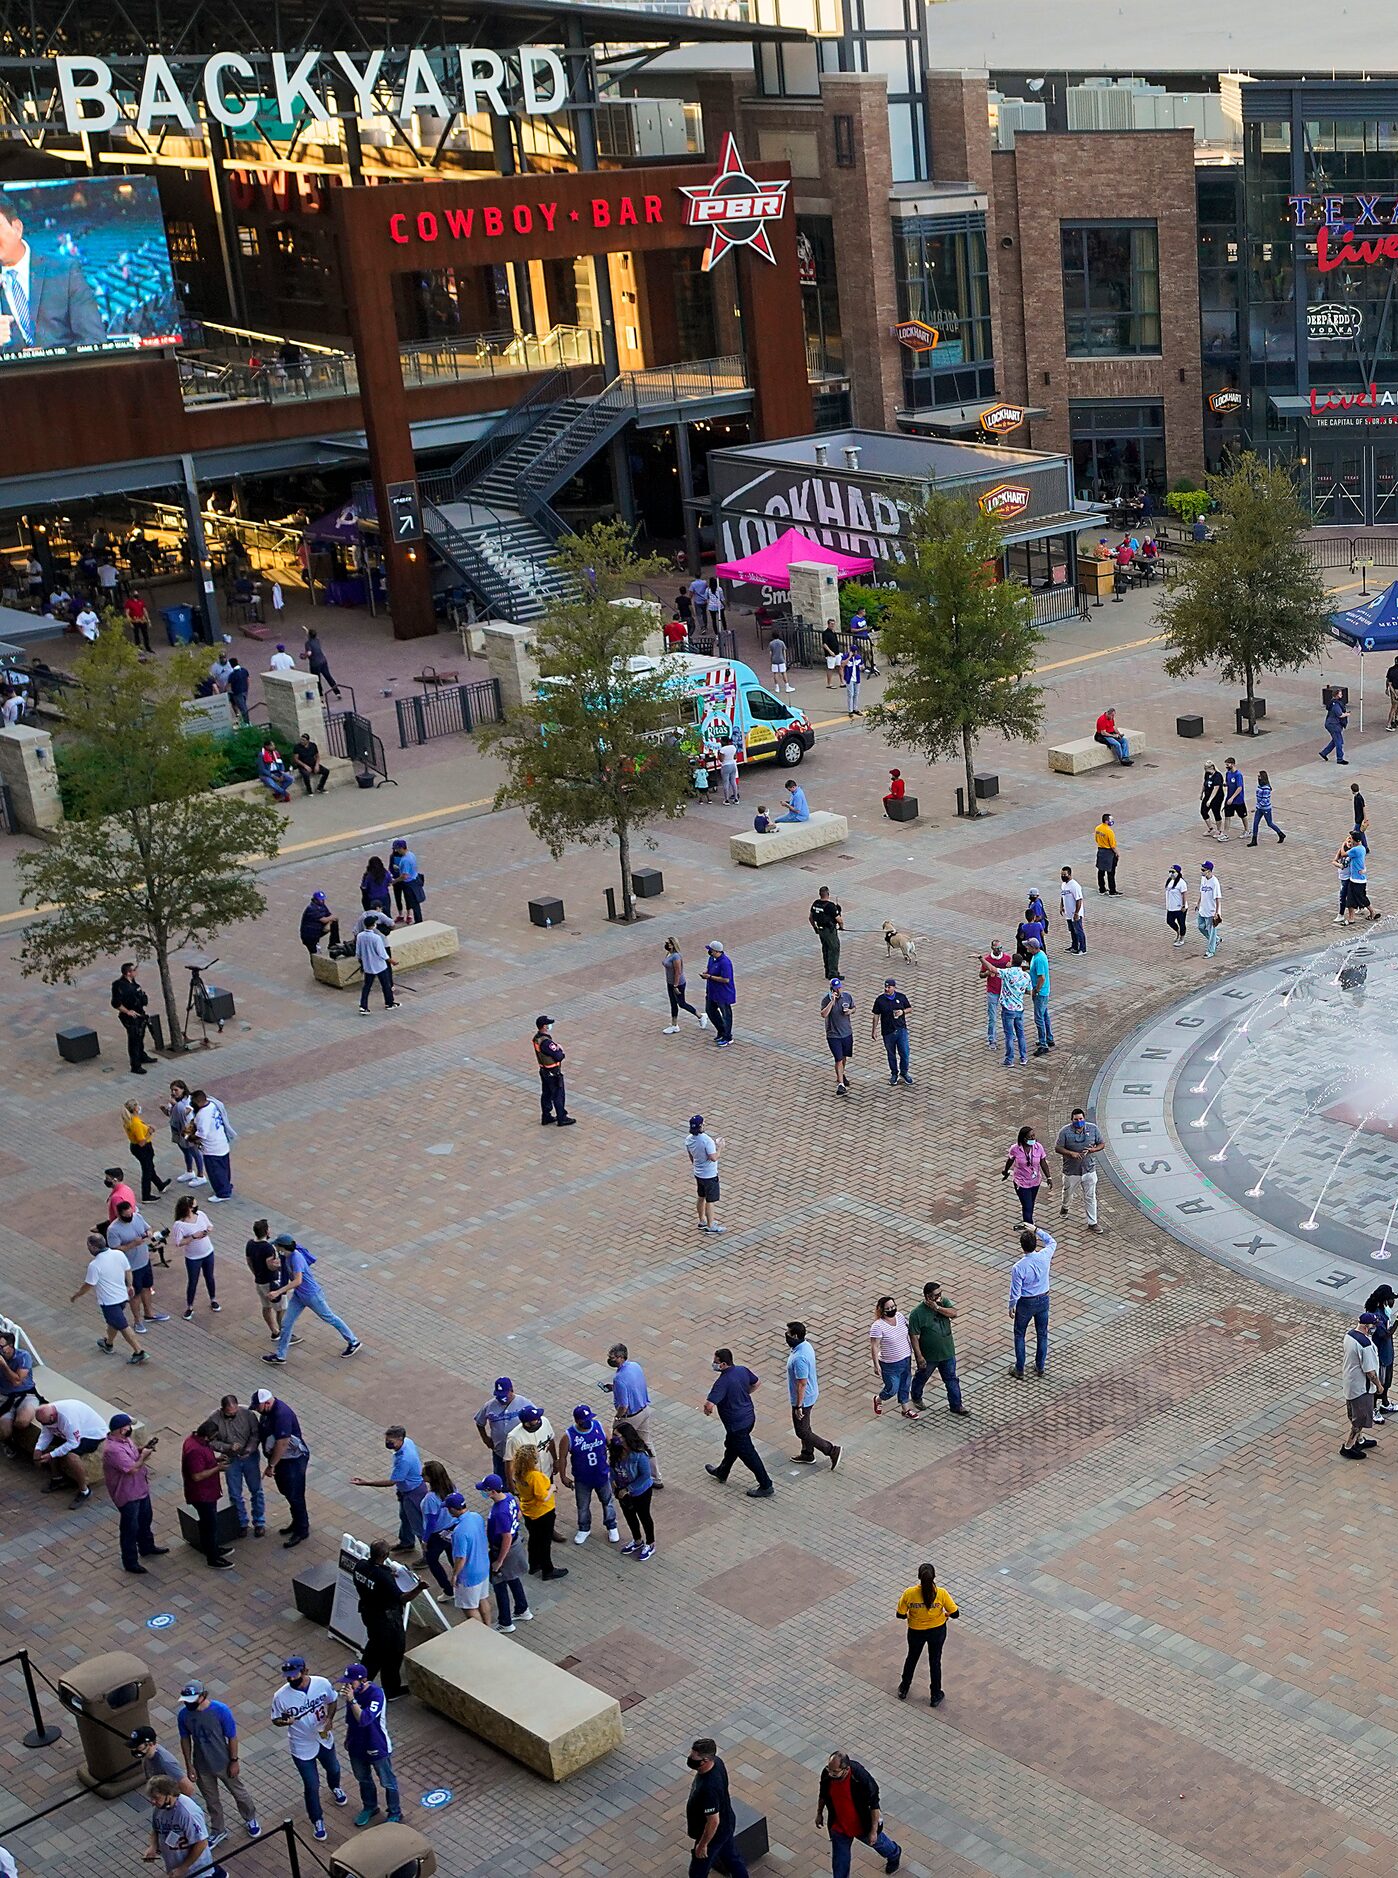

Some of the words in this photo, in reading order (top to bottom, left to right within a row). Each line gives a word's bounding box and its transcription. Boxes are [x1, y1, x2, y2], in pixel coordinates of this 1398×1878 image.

[56, 47, 571, 134] BACKYARD
[695, 192, 787, 224] PBR
[390, 202, 559, 244] COWBOY
[591, 196, 664, 228] BAR
[899, 326, 931, 344] LOCKHART
[1310, 326, 1353, 334] VODKA
[1310, 383, 1377, 416] Live!
[987, 408, 1021, 426] LOCKHART
[1329, 418, 1354, 426] CAPITAL
[988, 490, 1027, 512] LOCKHART
[707, 725, 728, 737] Rita's
[573, 1436, 584, 1447] Los
[581, 1438, 603, 1452] Angeles
[587, 1452, 597, 1467] 8
[288, 1692, 328, 1718] Dodgers
[314, 1705, 326, 1722] 13
[369, 1700, 380, 1713] 5
